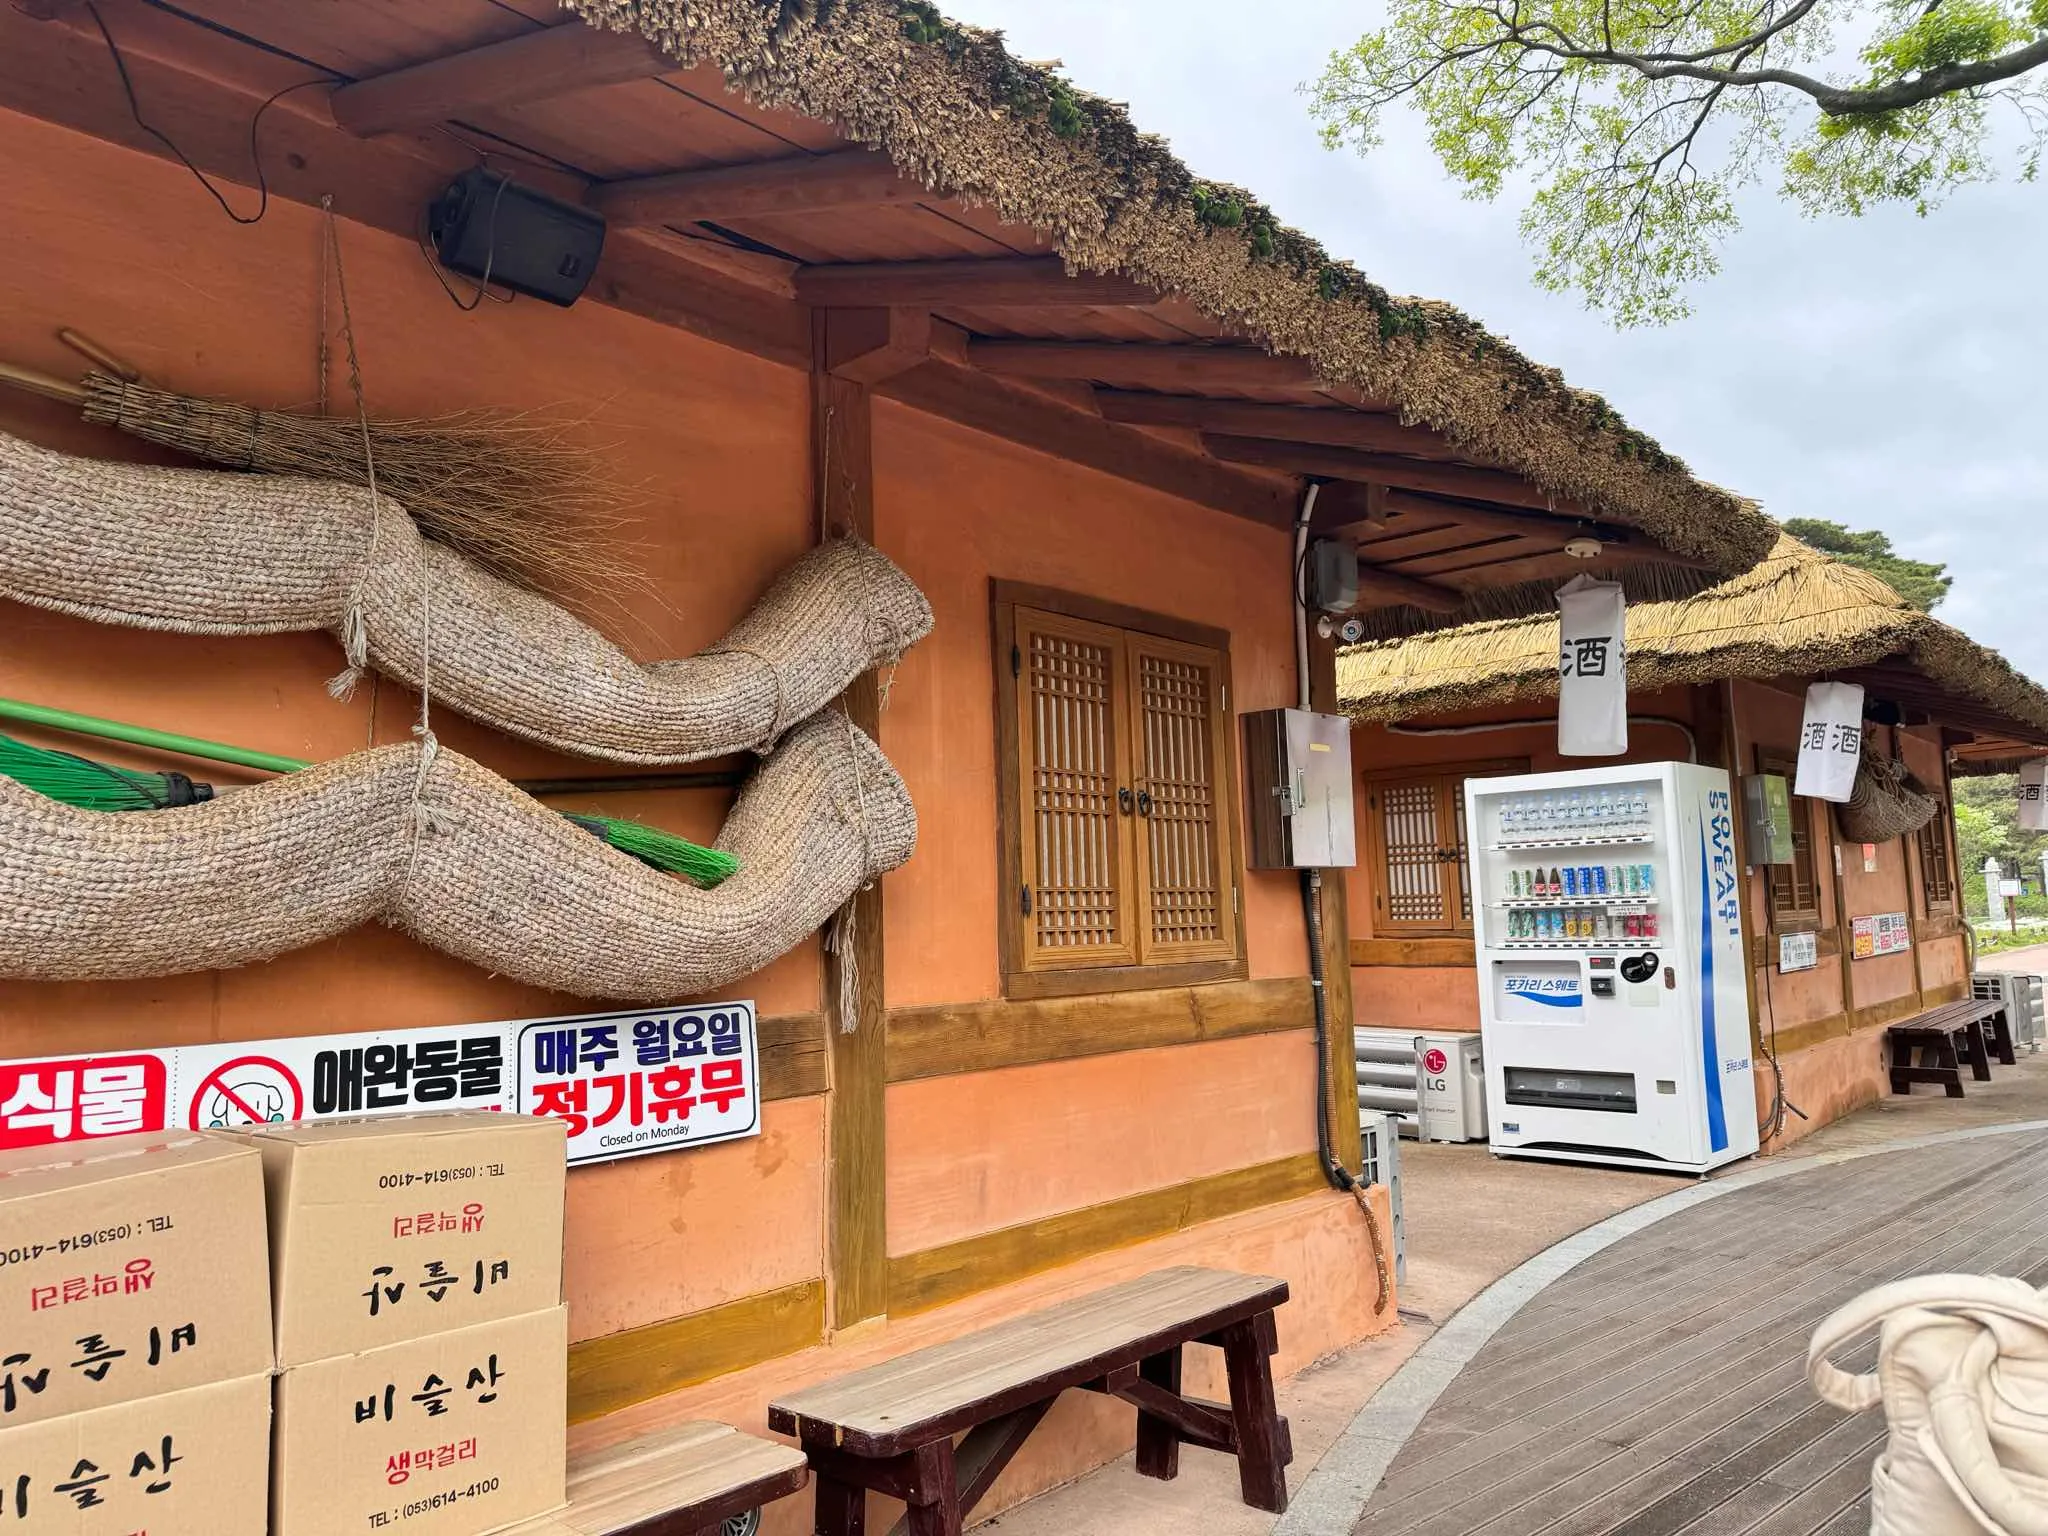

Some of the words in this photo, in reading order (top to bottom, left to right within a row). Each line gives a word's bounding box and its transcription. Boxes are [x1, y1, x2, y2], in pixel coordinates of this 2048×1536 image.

[1562, 637, 1612, 677] 酒
[1804, 722, 1827, 750] 酒
[1832, 724, 1860, 754] 酒
[2020, 783, 2041, 800] 酒
[1709, 789, 1728, 923] SWEAT
[1718, 791, 1739, 936] POCARI
[1505, 979, 1542, 990] 포카리
[1542, 979, 1579, 991] 스웨트
[535, 1025, 619, 1075] 매주
[632, 1012, 742, 1066] 월요일
[313, 1036, 503, 1114] 애완동물
[1427, 1078, 1446, 1091] LG
[1, 1064, 147, 1138] 식물
[532, 1059, 745, 1138] 정기휴무
[600, 1130, 633, 1147] Closed
[636, 1132, 649, 1142] on
[651, 1124, 690, 1141] Monday
[379, 1167, 476, 1188] (053)614-4100
[487, 1163, 505, 1176] TEL
[147, 1216, 173, 1232] TEL
[394, 1203, 485, 1238] 생막걸리
[32, 1258, 156, 1311] 생막걸리
[361, 1260, 509, 1316] 비슬산
[355, 1354, 505, 1423] 비슬산
[386, 1437, 477, 1485] 생막걸리
[368, 1511, 391, 1528] TEL
[402, 1477, 499, 1519] (053)614-4100
